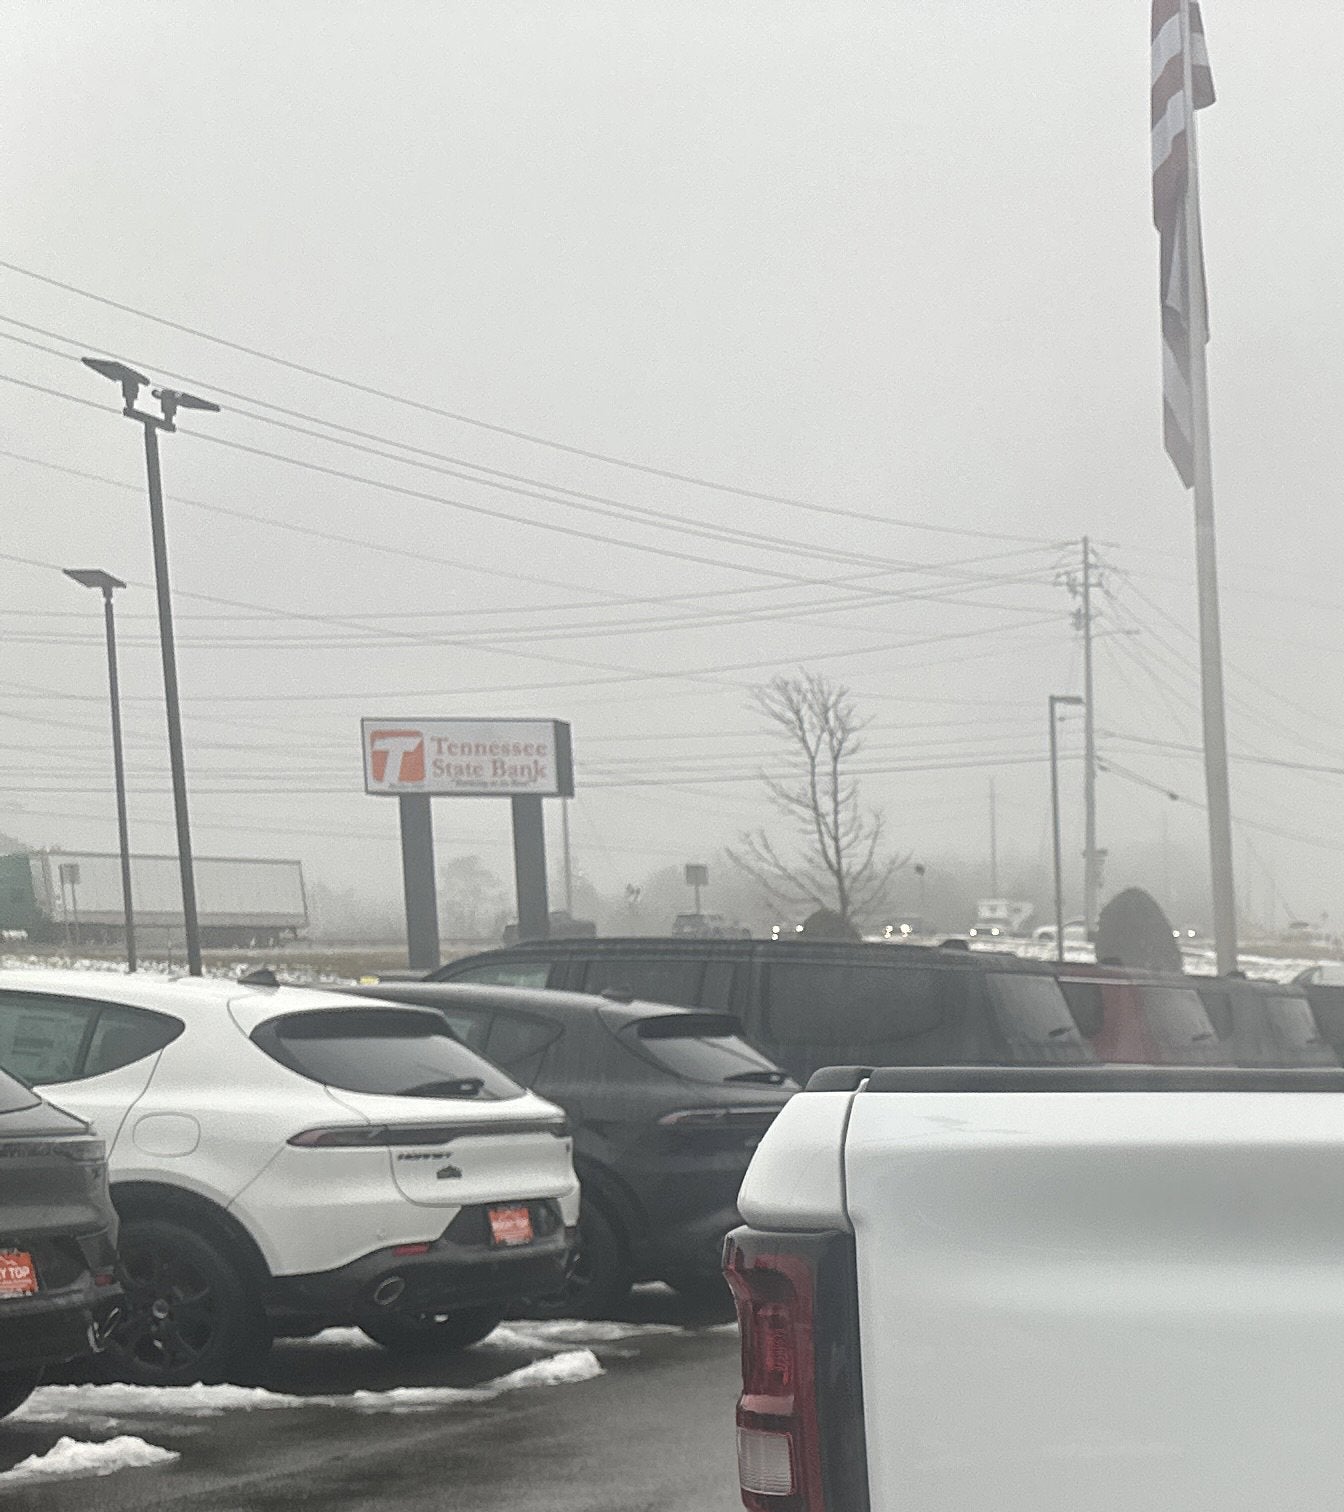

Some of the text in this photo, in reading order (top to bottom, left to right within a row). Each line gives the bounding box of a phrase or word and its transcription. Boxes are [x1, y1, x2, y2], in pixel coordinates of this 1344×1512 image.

[431, 736, 547, 756] Tennessee
[432, 759, 547, 780] State Bank
[9, 1266, 30, 1279] TOP
